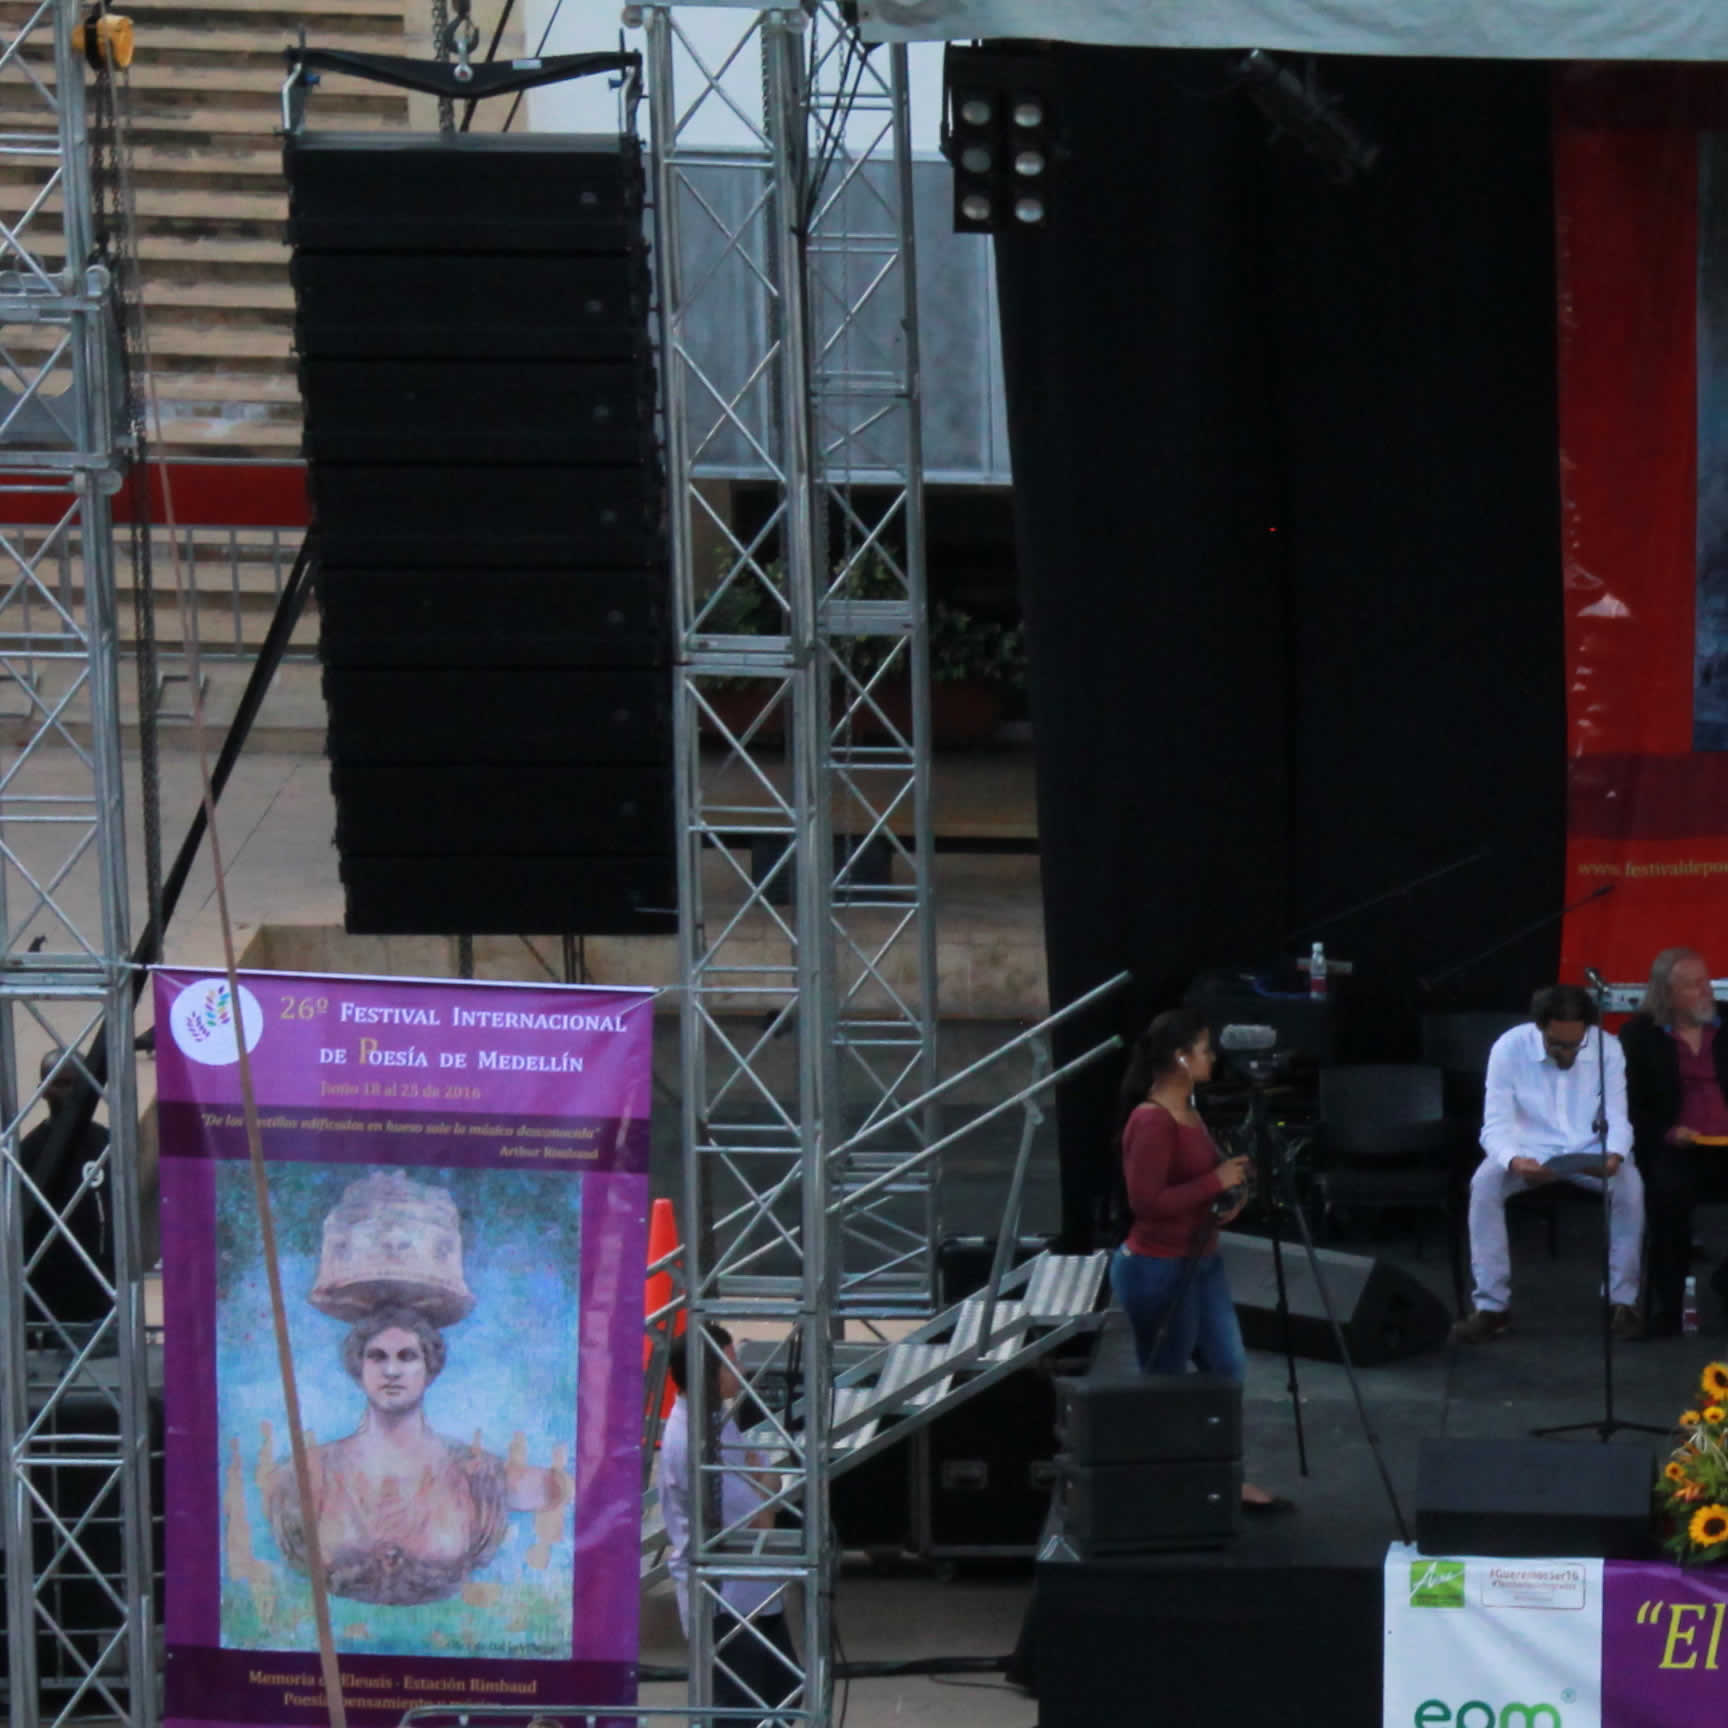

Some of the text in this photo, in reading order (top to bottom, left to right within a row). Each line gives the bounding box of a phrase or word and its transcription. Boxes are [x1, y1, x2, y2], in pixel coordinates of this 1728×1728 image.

[452, 1006, 627, 1033] INTERNACIONAL
[320, 1047, 347, 1065] DE
[439, 1052, 467, 1069] DE
[478, 1050, 584, 1073] MEDELLÍN
[1635, 1601, 1725, 1671] “El
[249, 1670, 315, 1688] Memoria
[342, 1673, 394, 1689] Eleusis
[403, 1675, 466, 1693] Estación
[469, 1678, 538, 1695] Rimbaud
